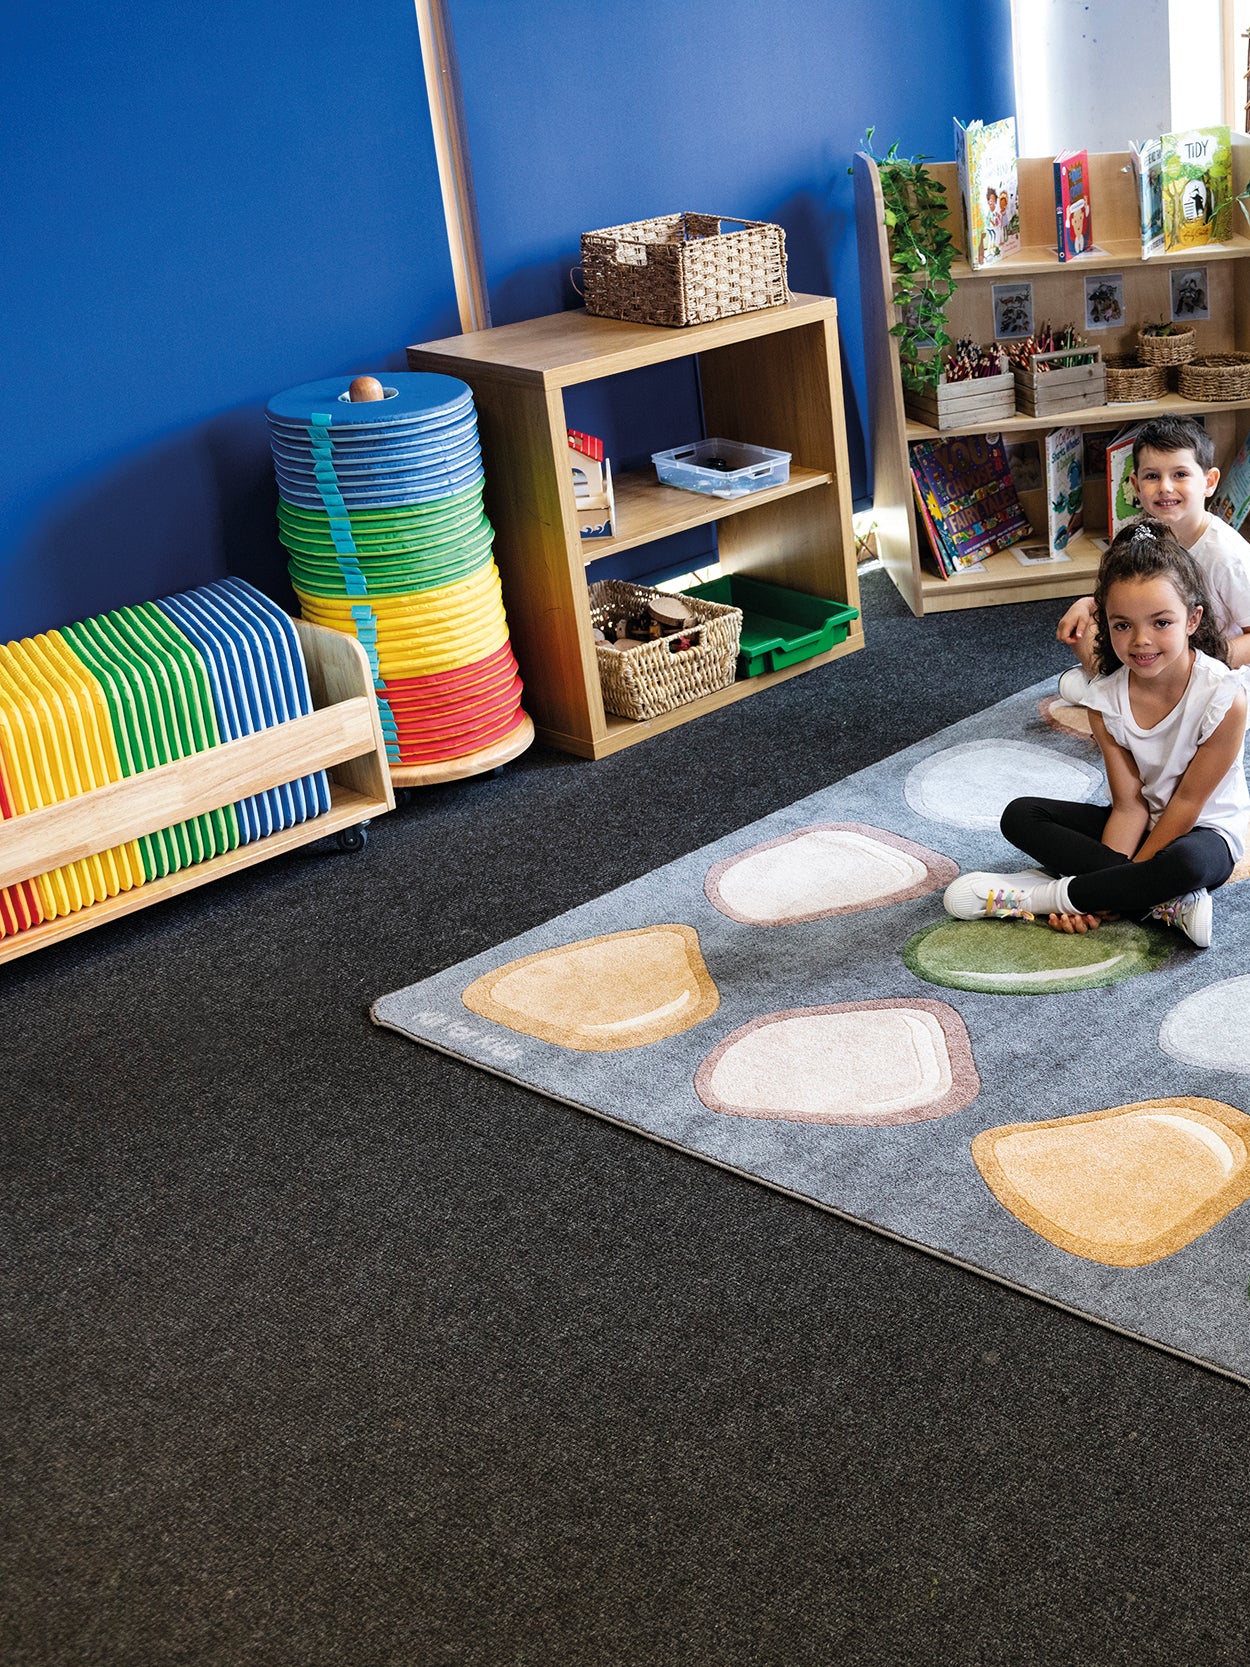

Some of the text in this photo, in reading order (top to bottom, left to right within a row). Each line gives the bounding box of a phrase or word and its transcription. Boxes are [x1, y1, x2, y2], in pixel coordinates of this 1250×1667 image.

[1184, 139, 1209, 160] TIDY
[933, 437, 988, 479] YOU
[946, 463, 995, 499] CHOOSE
[948, 505, 982, 532] FAIRY
